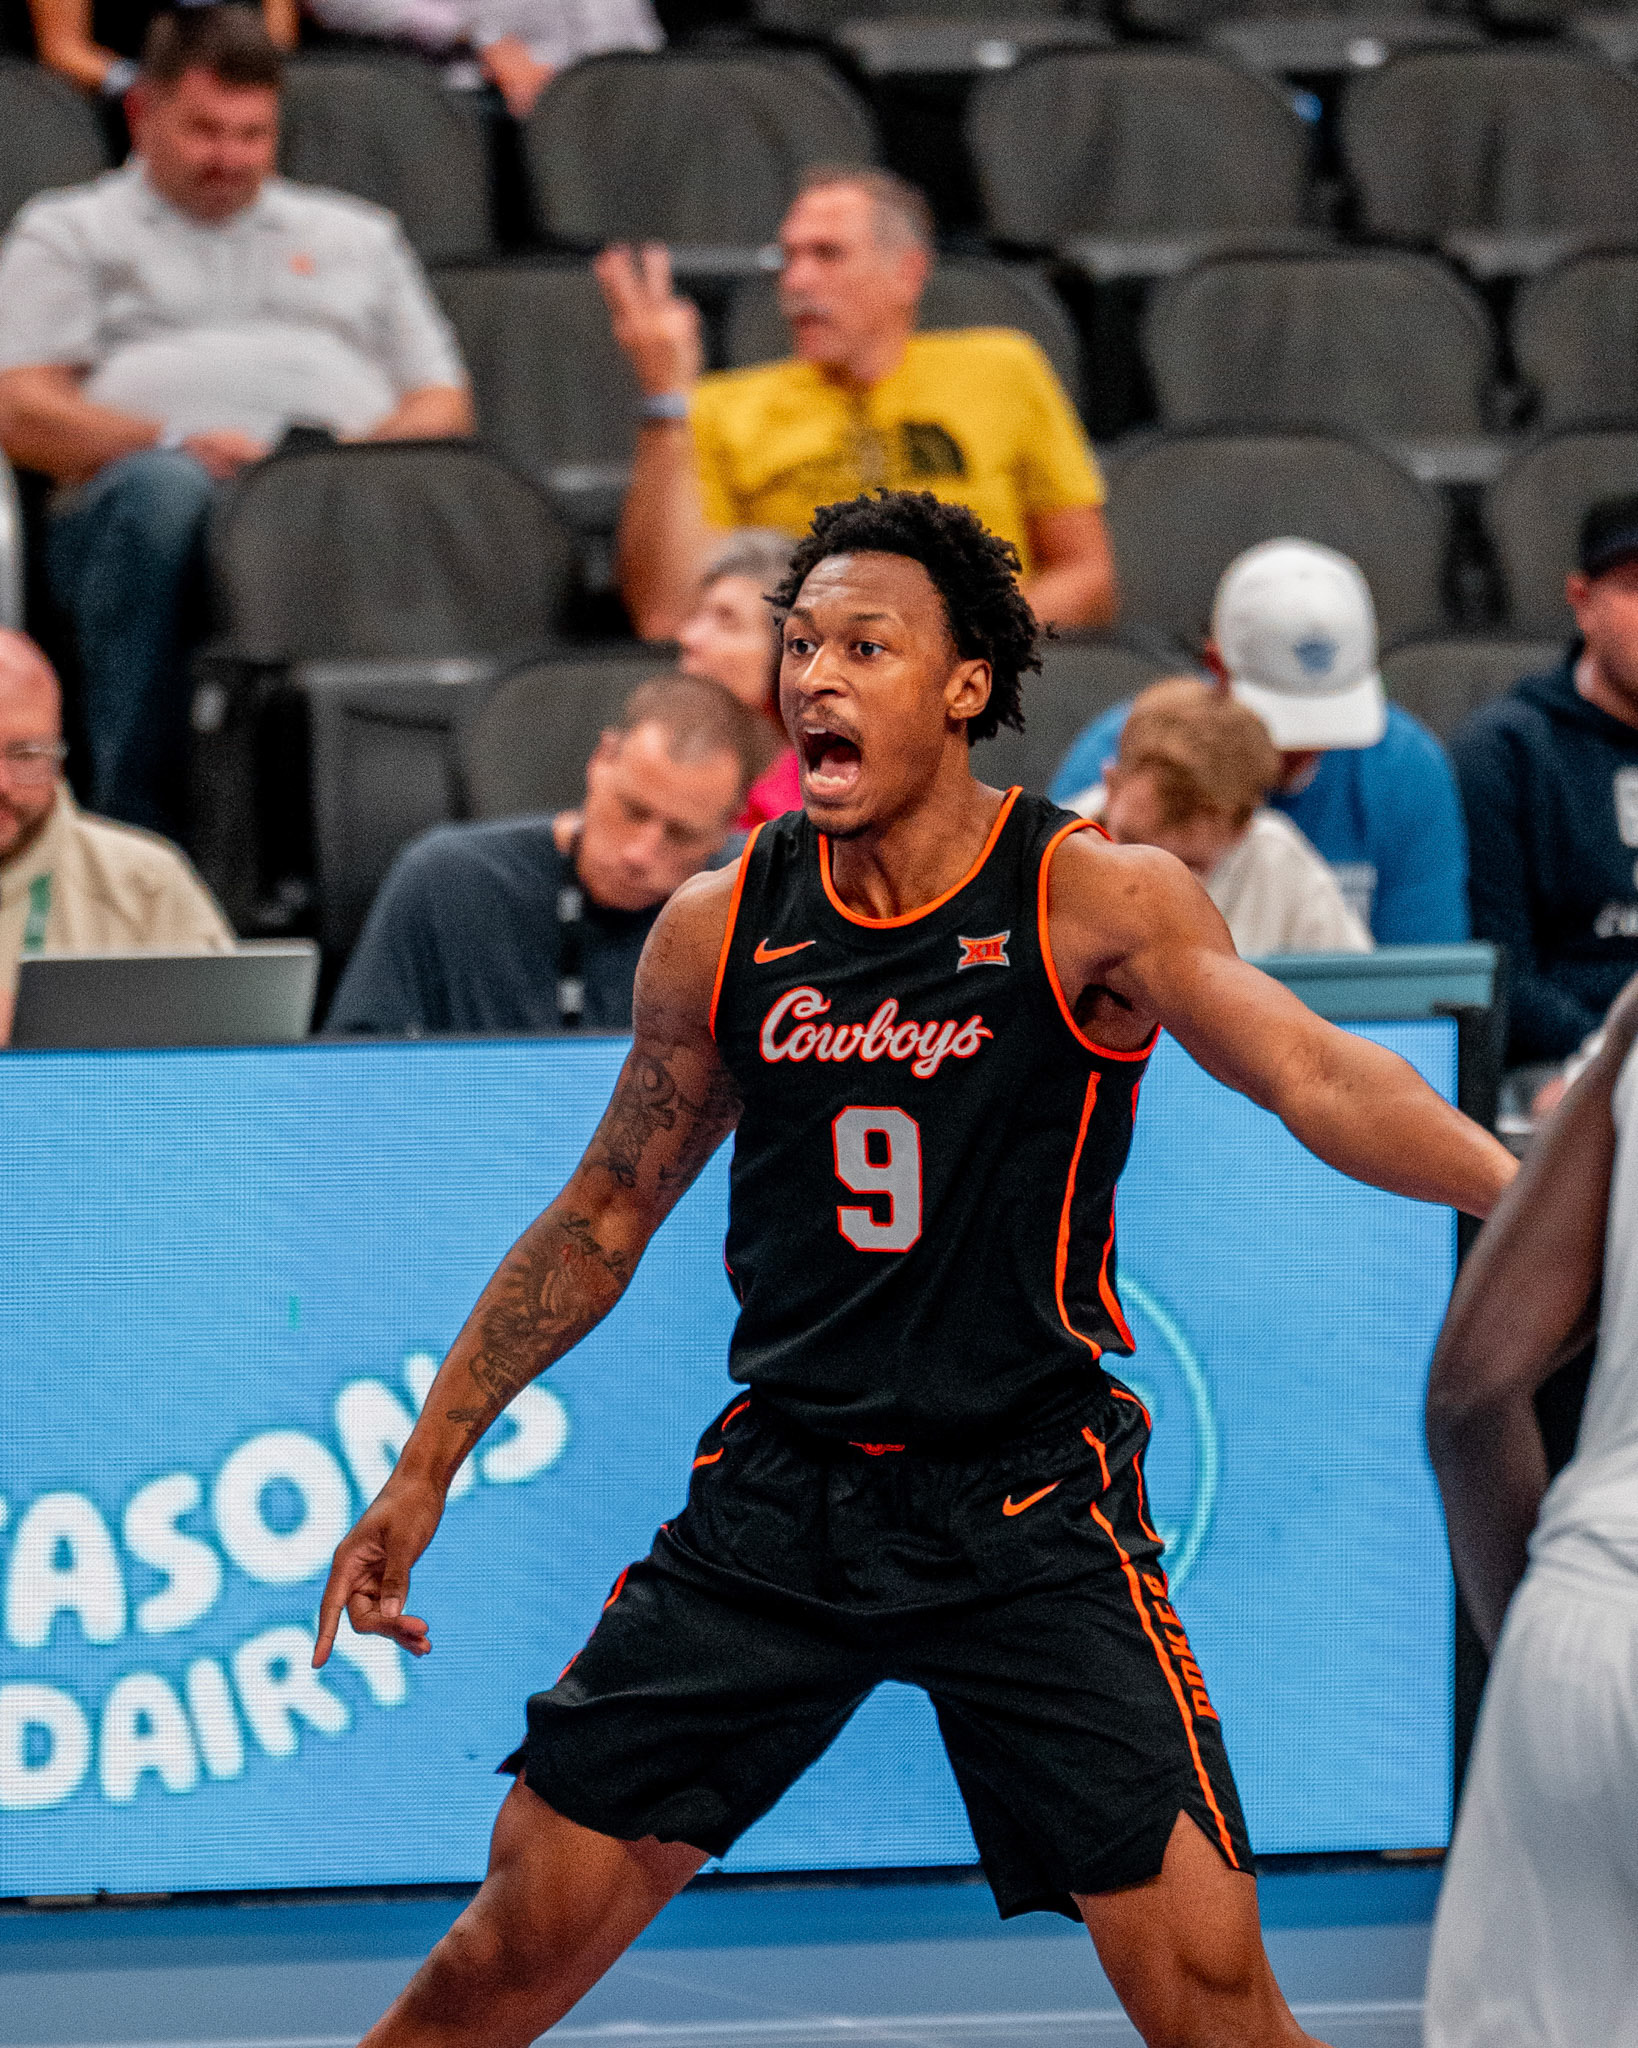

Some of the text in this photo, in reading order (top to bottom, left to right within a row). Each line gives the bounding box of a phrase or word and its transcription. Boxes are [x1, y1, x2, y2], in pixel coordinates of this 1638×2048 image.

[759, 986, 993, 1079] Cowboys
[831, 1105, 922, 1253] 9
[0, 1352, 568, 1648] ASONS
[1142, 1573, 1220, 1721] POKES
